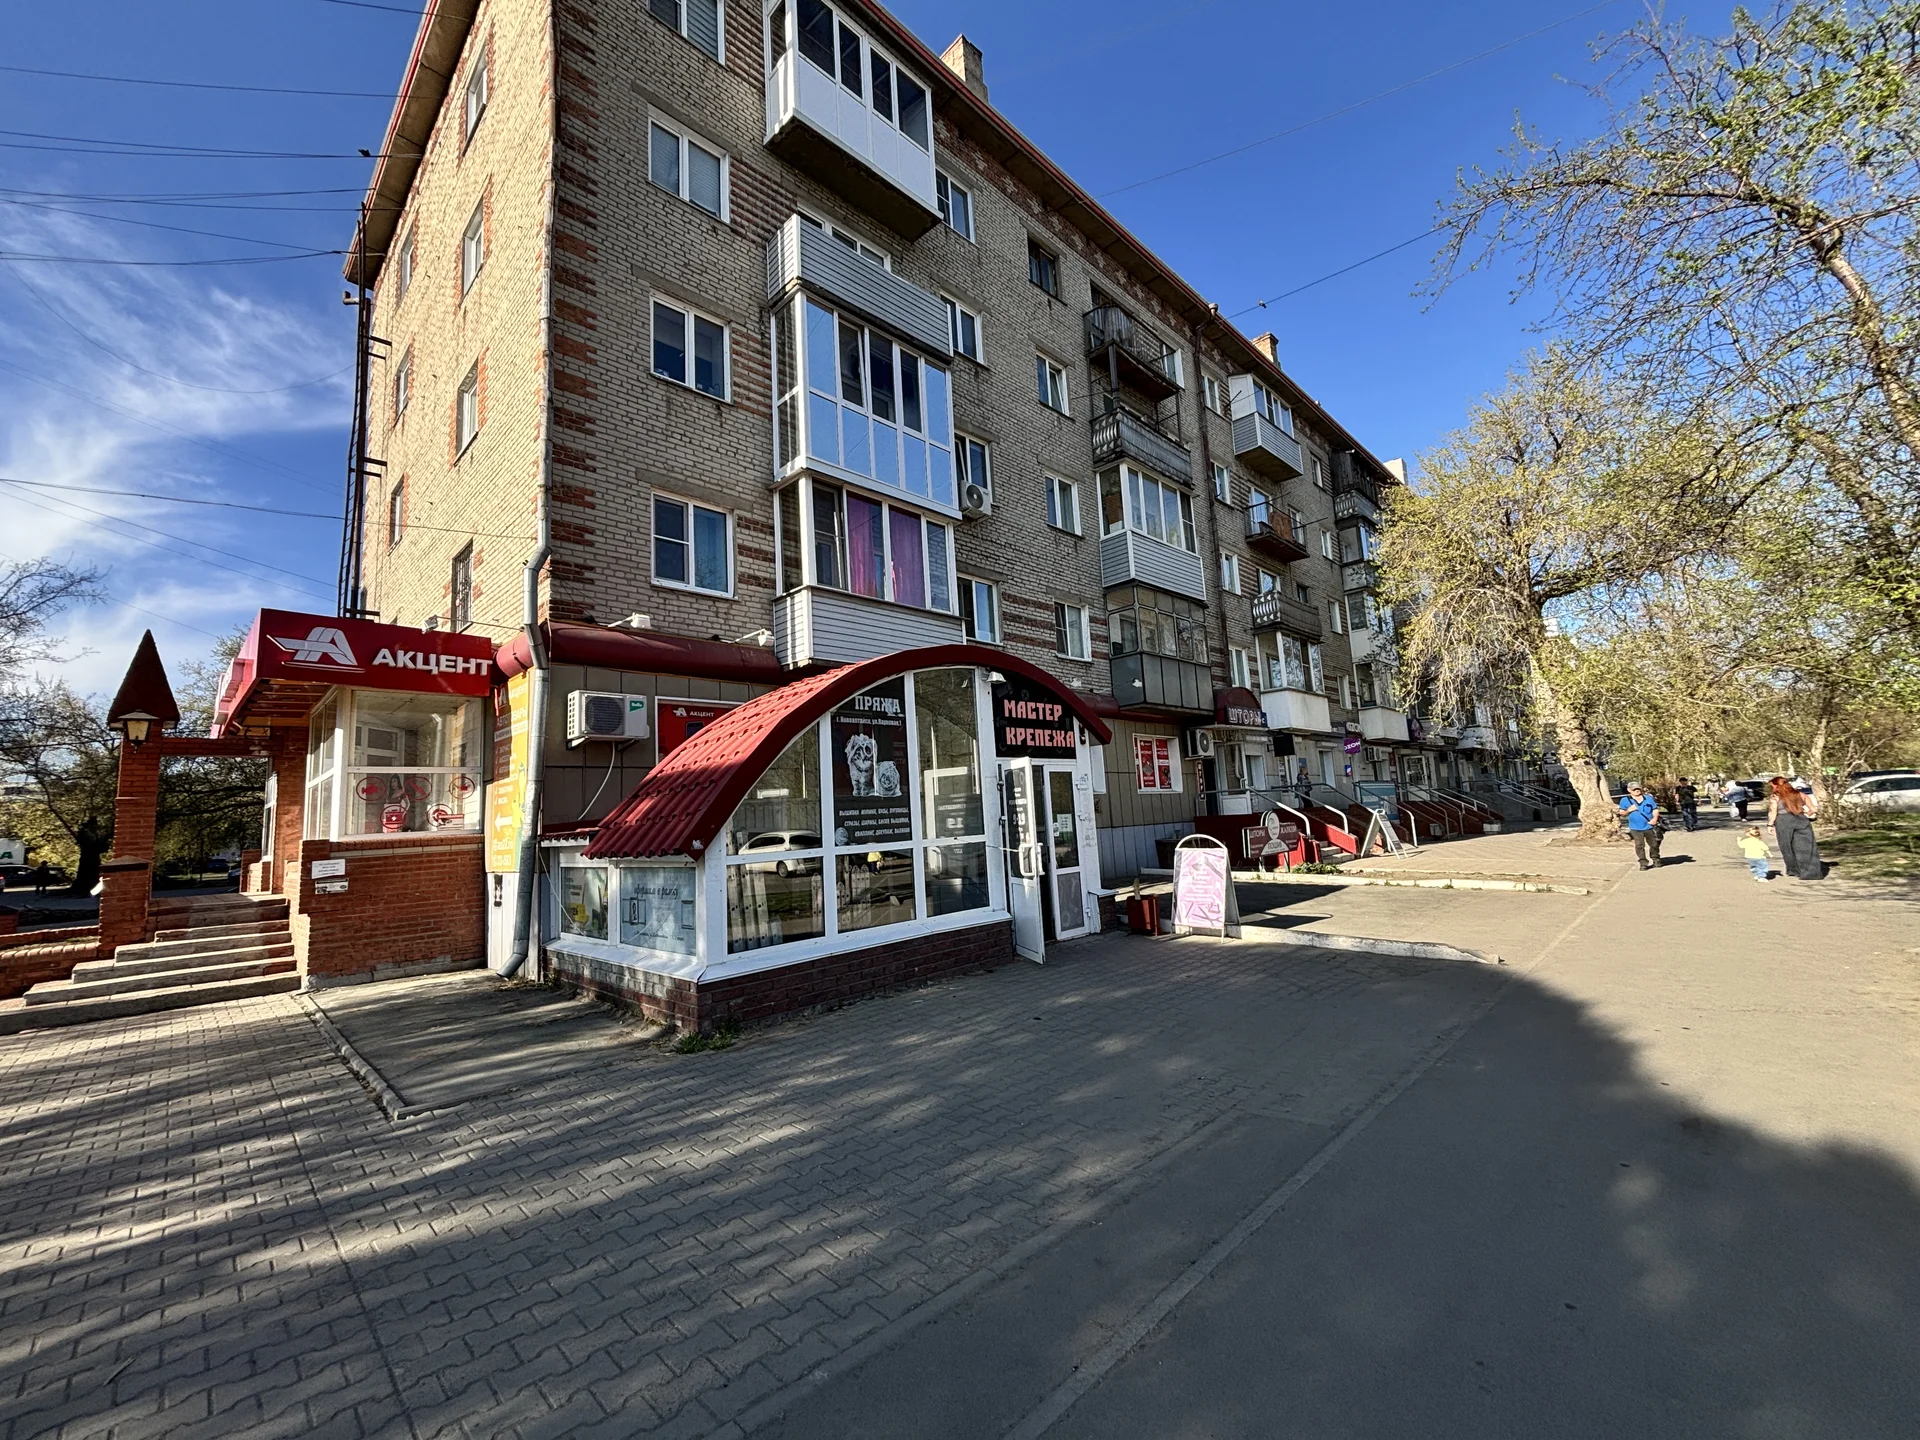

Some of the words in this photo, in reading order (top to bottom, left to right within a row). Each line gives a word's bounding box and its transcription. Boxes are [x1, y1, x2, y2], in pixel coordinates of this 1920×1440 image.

[372, 648, 493, 676] АКЦЕНТ
[854, 695, 901, 713] ПРЯЖА
[1004, 699, 1062, 721] МАСТЕР
[1228, 707, 1261, 725] ШТОРЫ
[1005, 727, 1074, 748] КРЕПЕЖА
